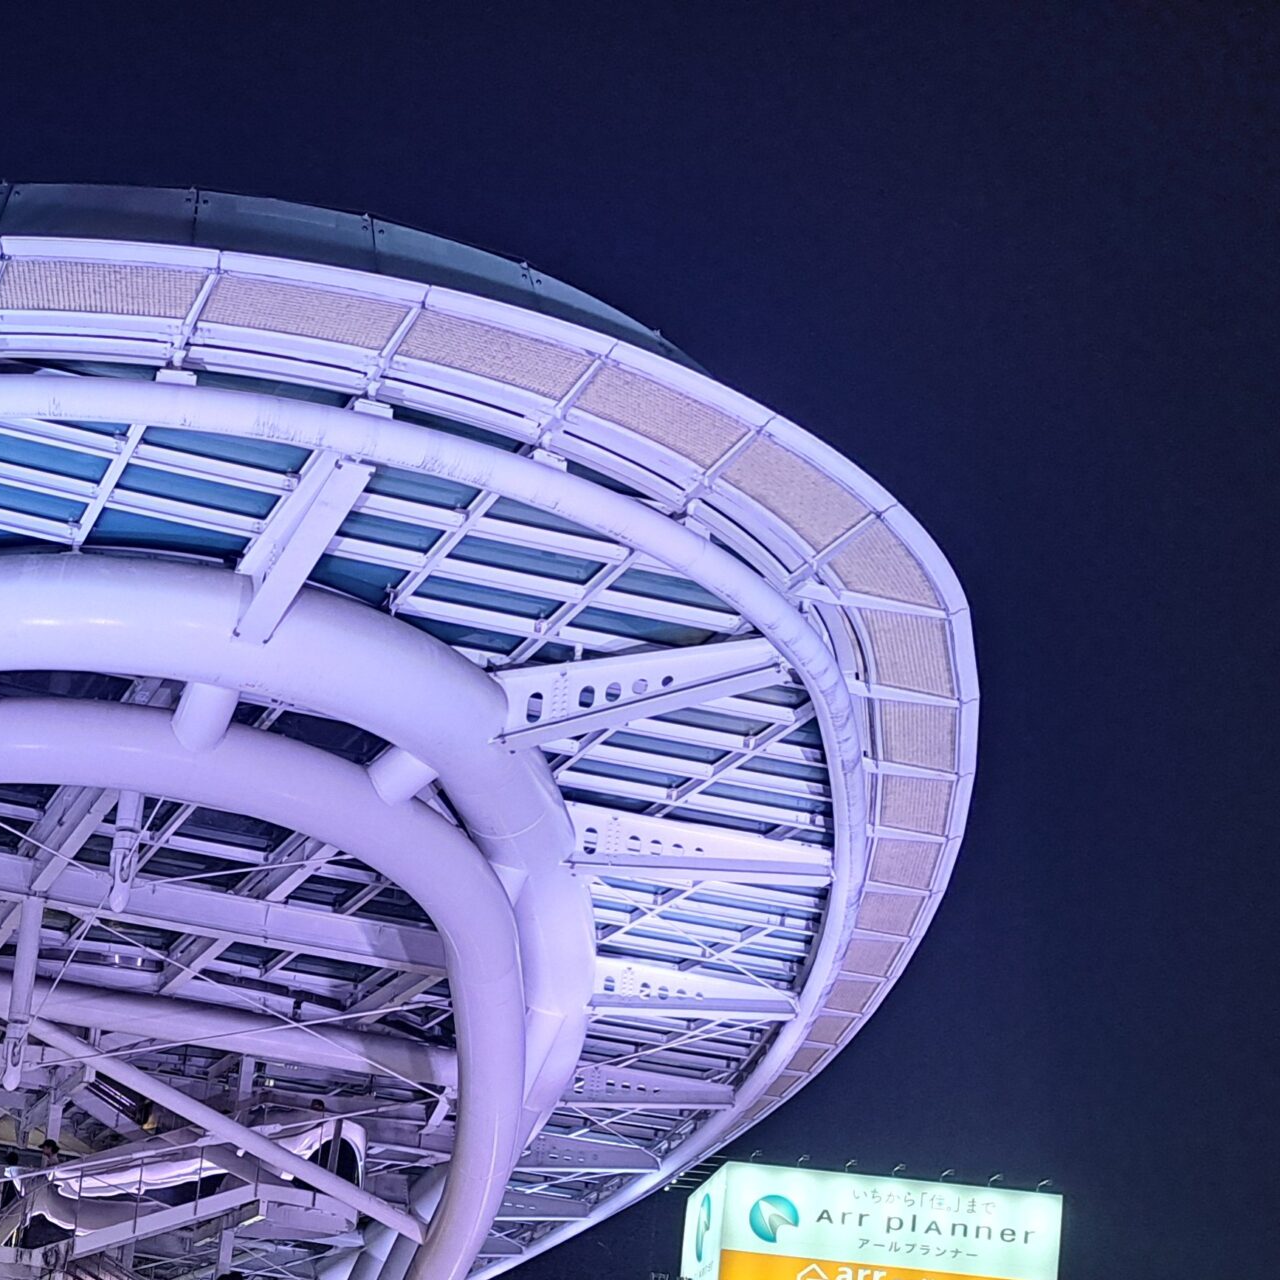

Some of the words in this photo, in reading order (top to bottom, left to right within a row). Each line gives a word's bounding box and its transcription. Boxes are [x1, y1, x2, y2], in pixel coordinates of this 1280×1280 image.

[858, 1238, 979, 1259] アールプランナー
